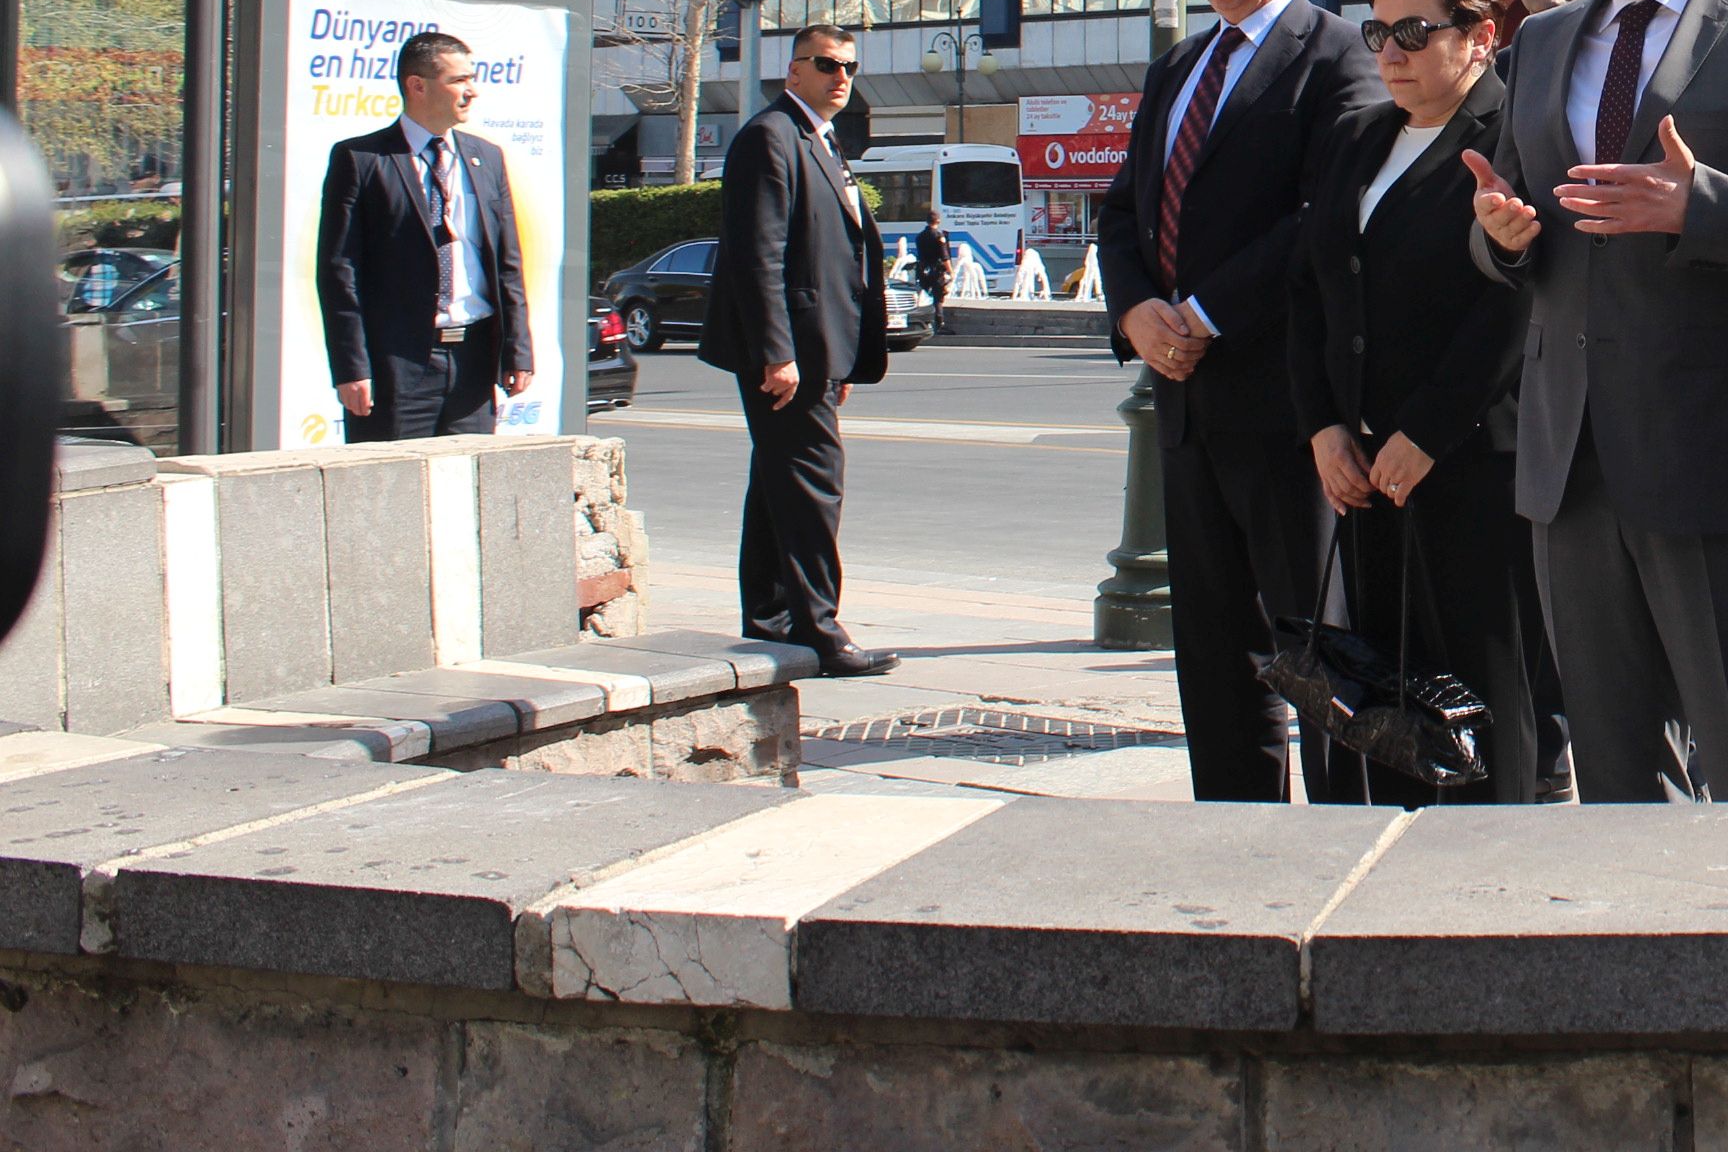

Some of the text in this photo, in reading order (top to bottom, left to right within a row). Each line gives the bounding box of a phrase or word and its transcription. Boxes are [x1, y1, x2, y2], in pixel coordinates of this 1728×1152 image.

[627, 16, 659, 29] 100
[310, 49, 525, 85] en hızl neti
[311, 84, 401, 118] Turkce
[1068, 147, 1129, 165] vodafon
